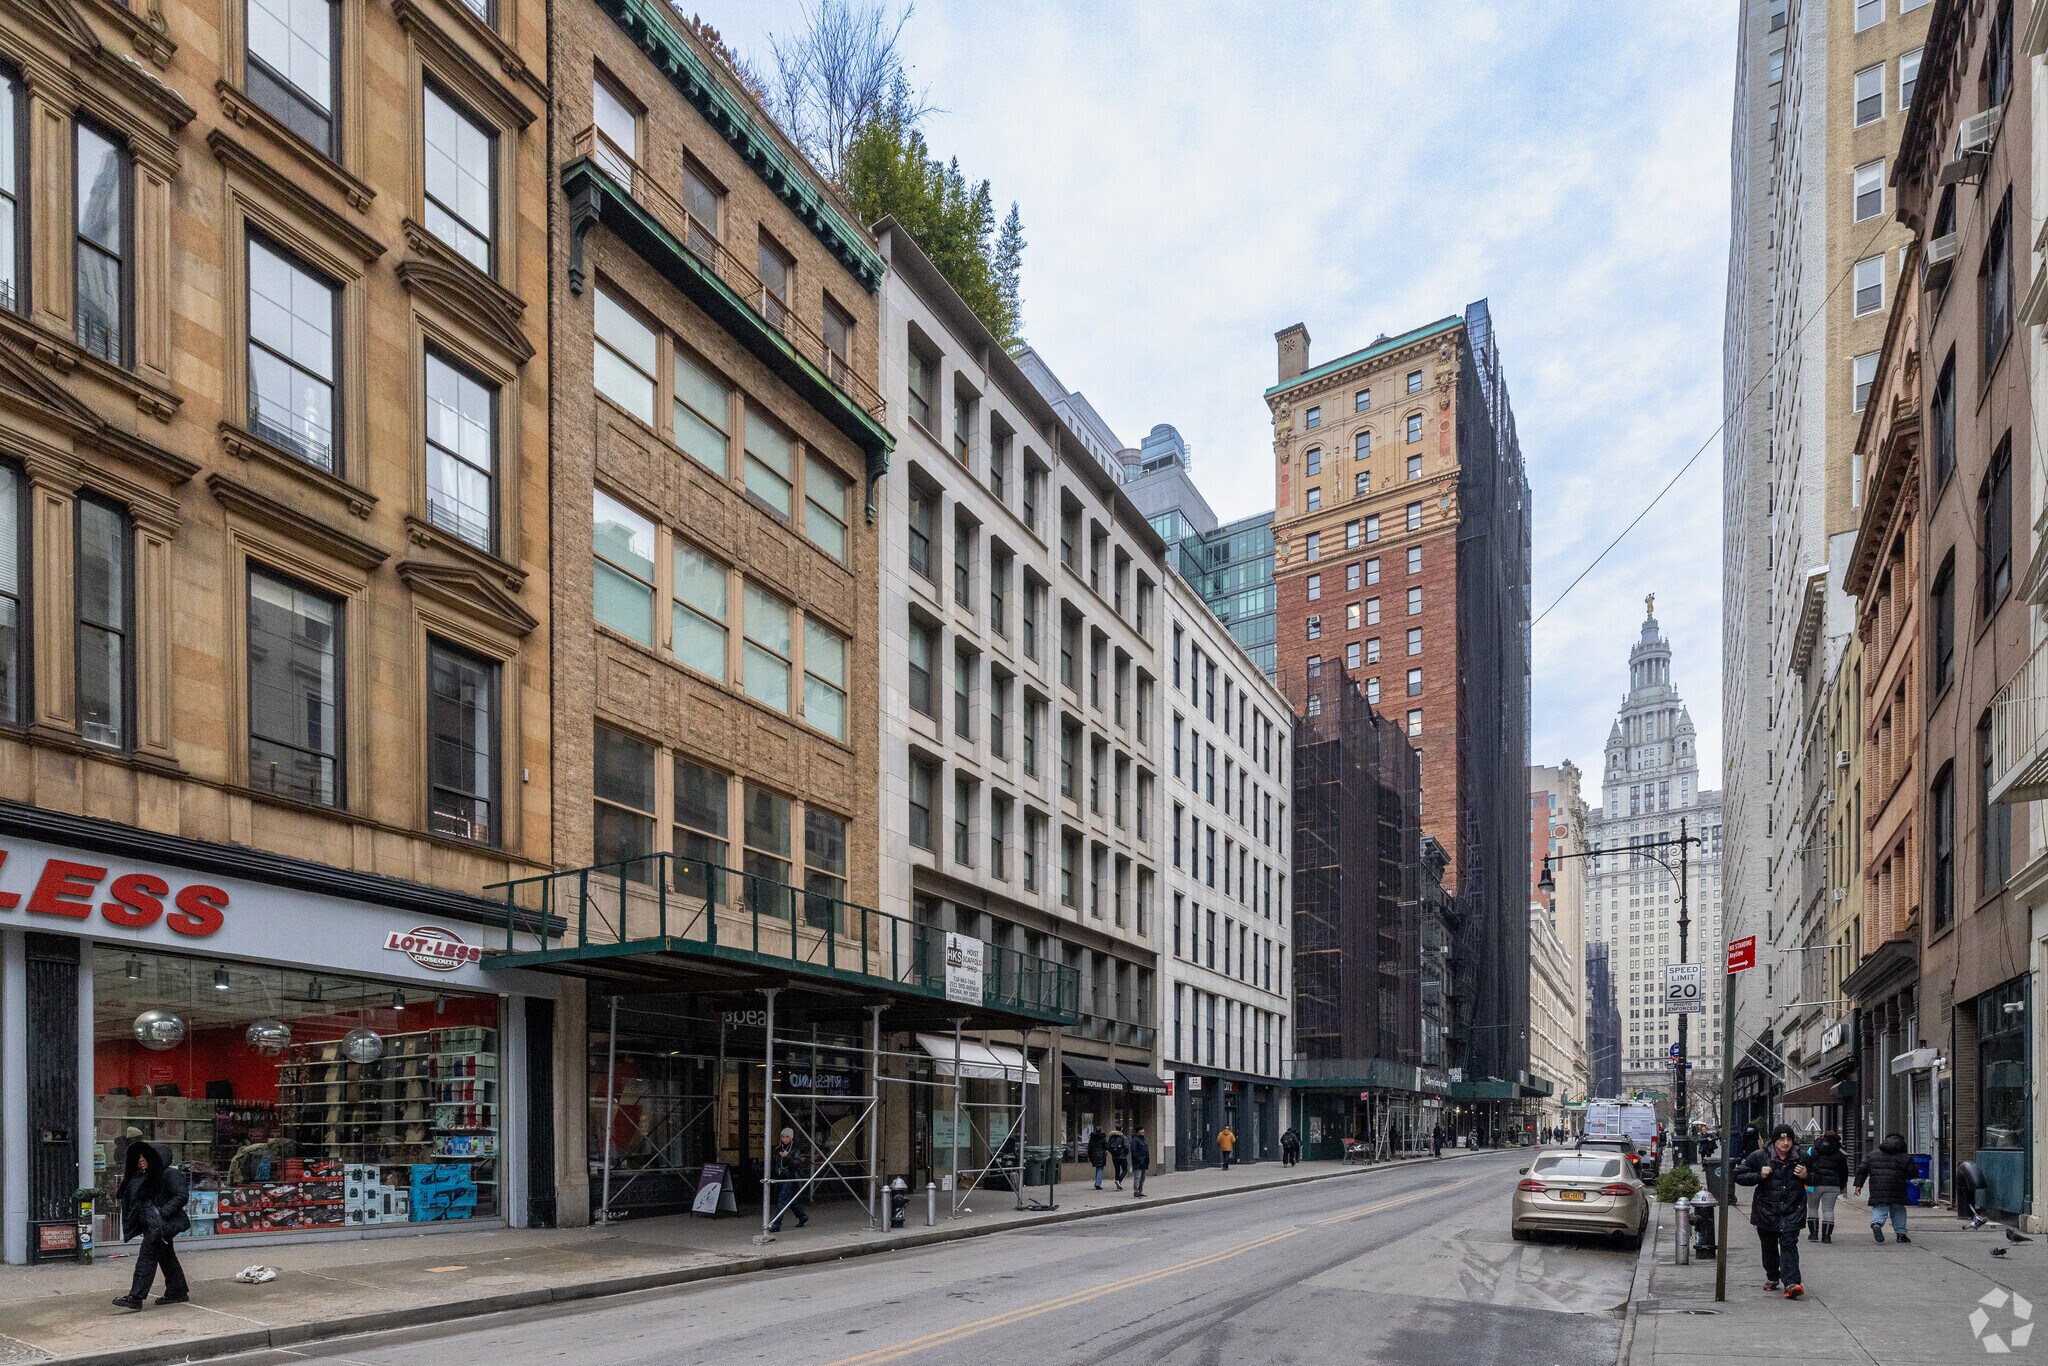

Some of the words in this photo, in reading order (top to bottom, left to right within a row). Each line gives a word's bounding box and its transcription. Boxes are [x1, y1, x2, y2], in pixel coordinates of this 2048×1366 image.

[389, 934, 481, 961] LOT-LESS
[1735, 939, 1753, 949] STANDING
[947, 949, 962, 963] HKS
[967, 949, 979, 957] HOIST
[1729, 950, 1744, 959] Anytime
[414, 955, 458, 967] CLOSEOUTS
[963, 956, 982, 966] SCAFFOLD
[1669, 966, 1698, 974] SPEED
[1669, 984, 1697, 998] 20
[725, 1010, 768, 1030] spea
[1083, 1080, 1101, 1088] EUROPEAN
